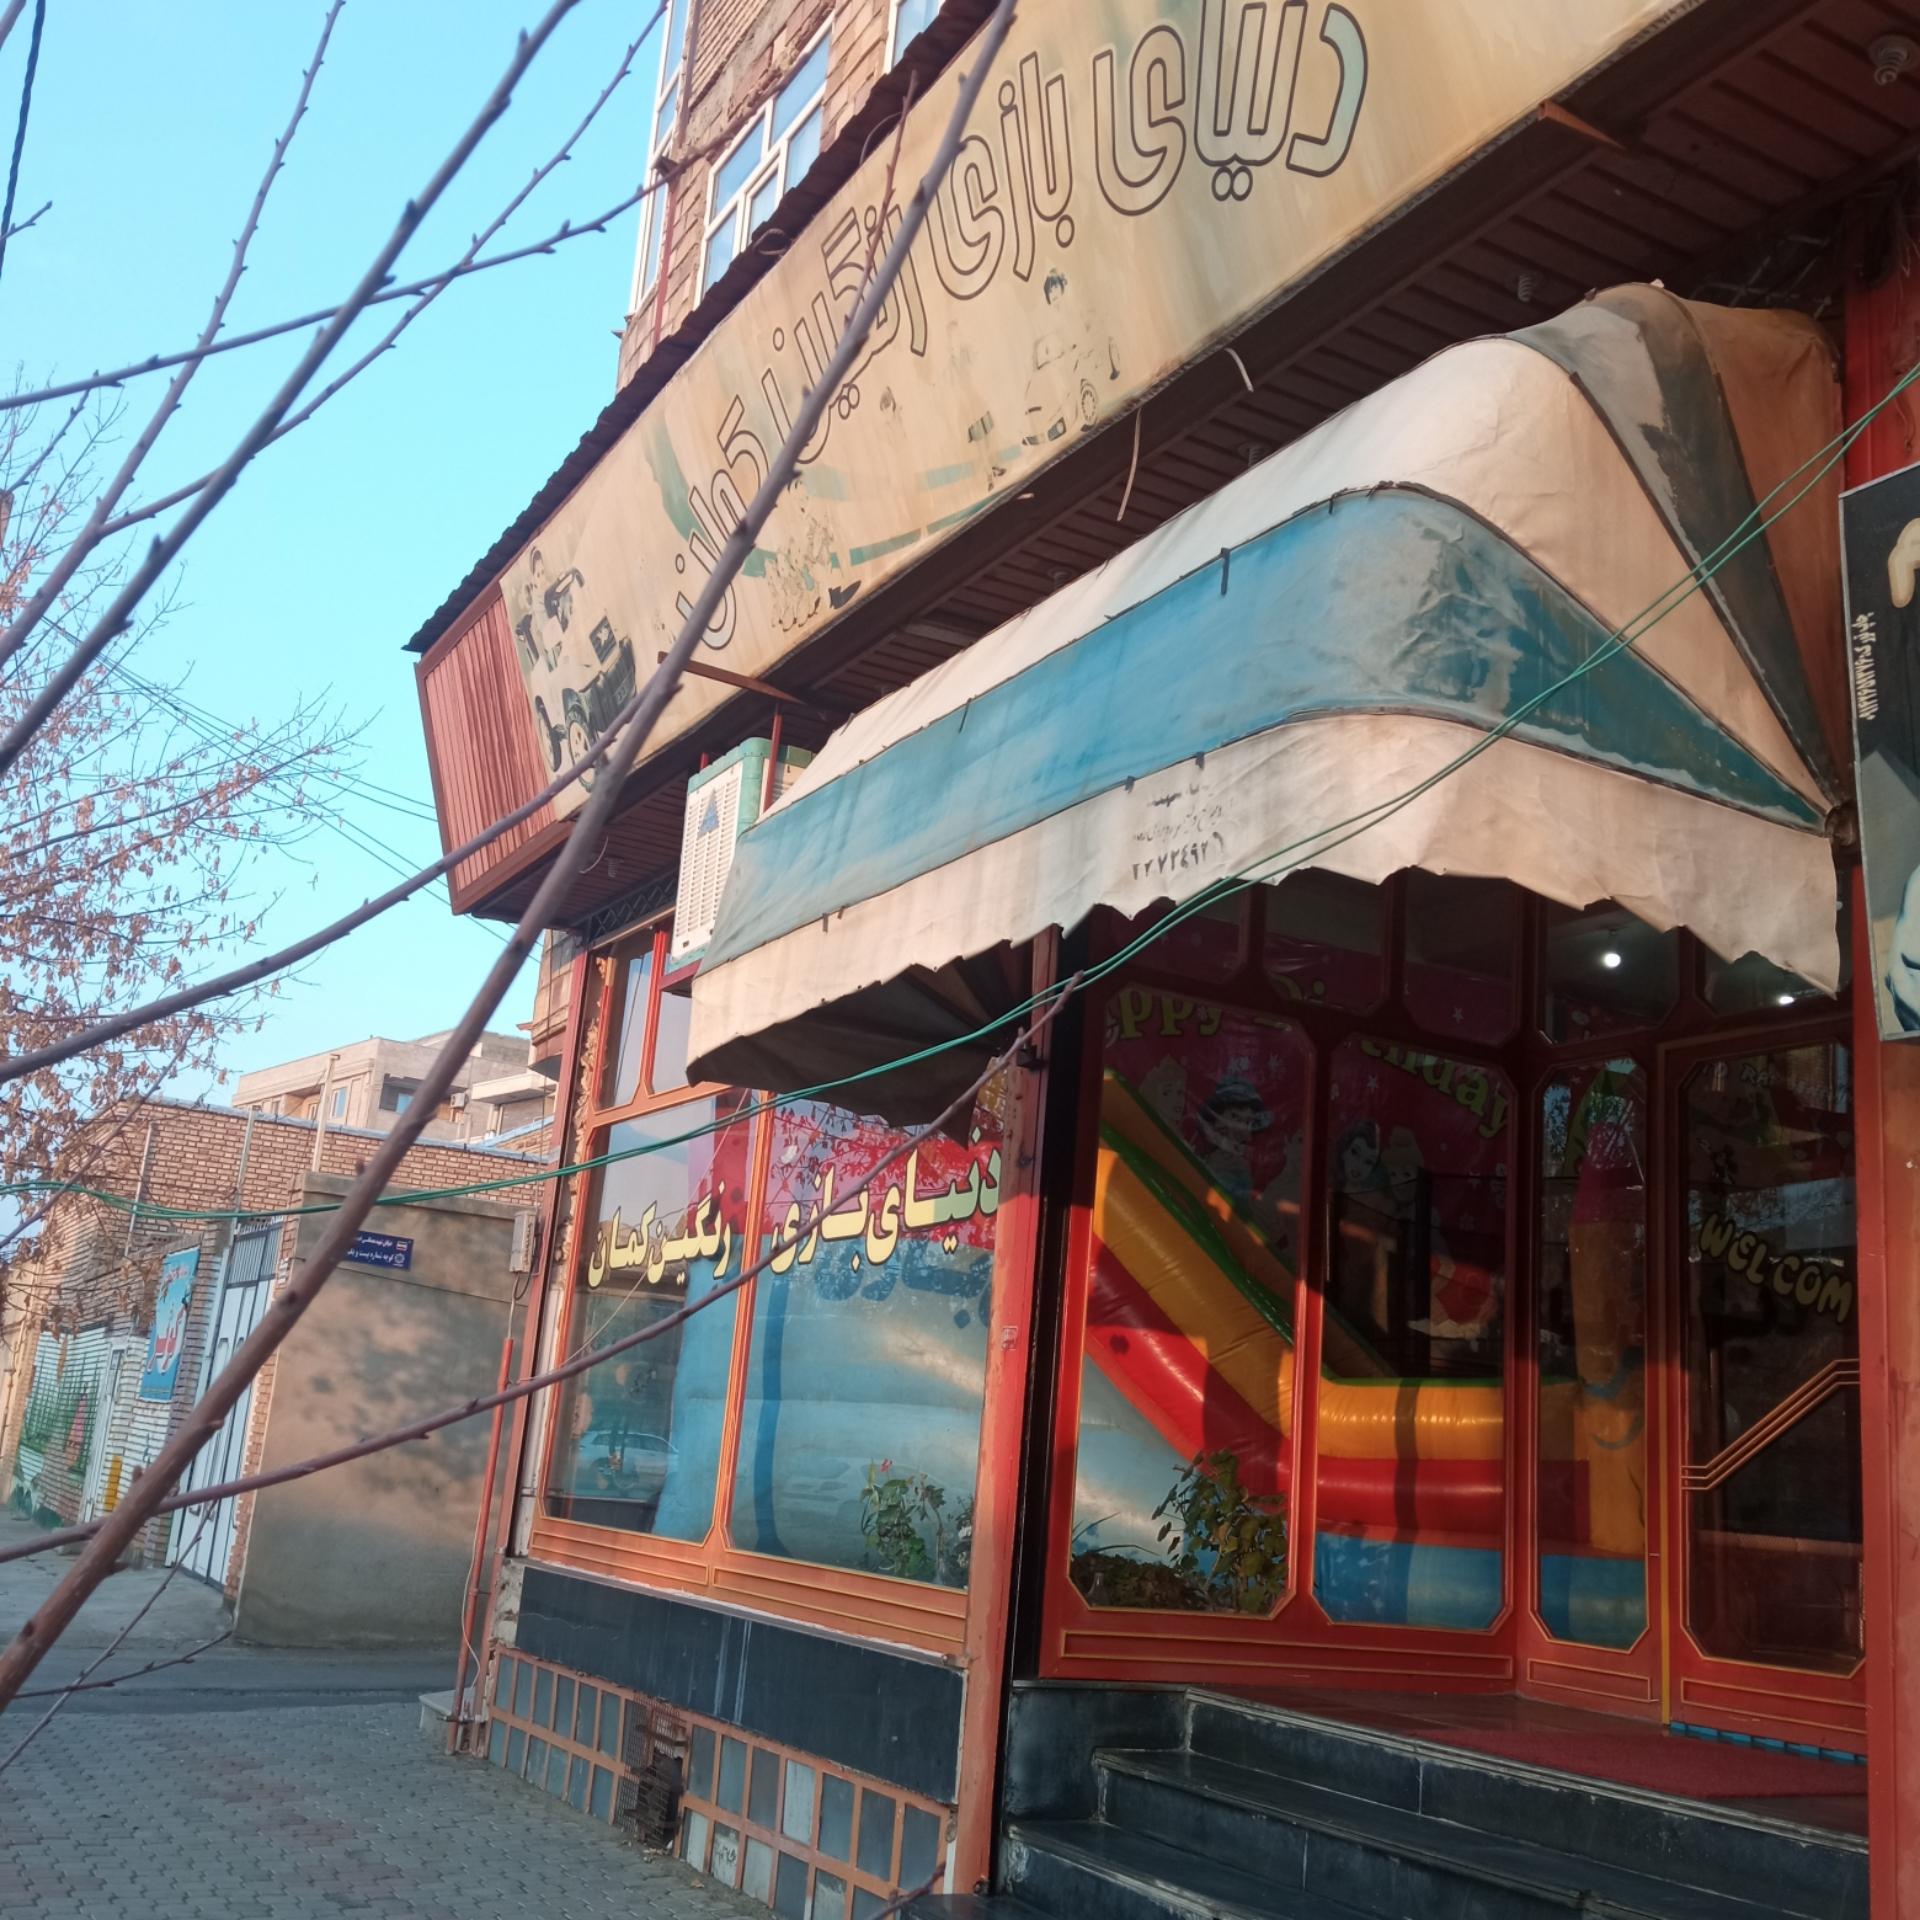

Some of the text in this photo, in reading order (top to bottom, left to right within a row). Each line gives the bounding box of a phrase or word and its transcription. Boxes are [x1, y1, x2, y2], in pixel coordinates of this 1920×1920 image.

[586, 1125, 1002, 1288] دنیای بازی رنگین کمان
